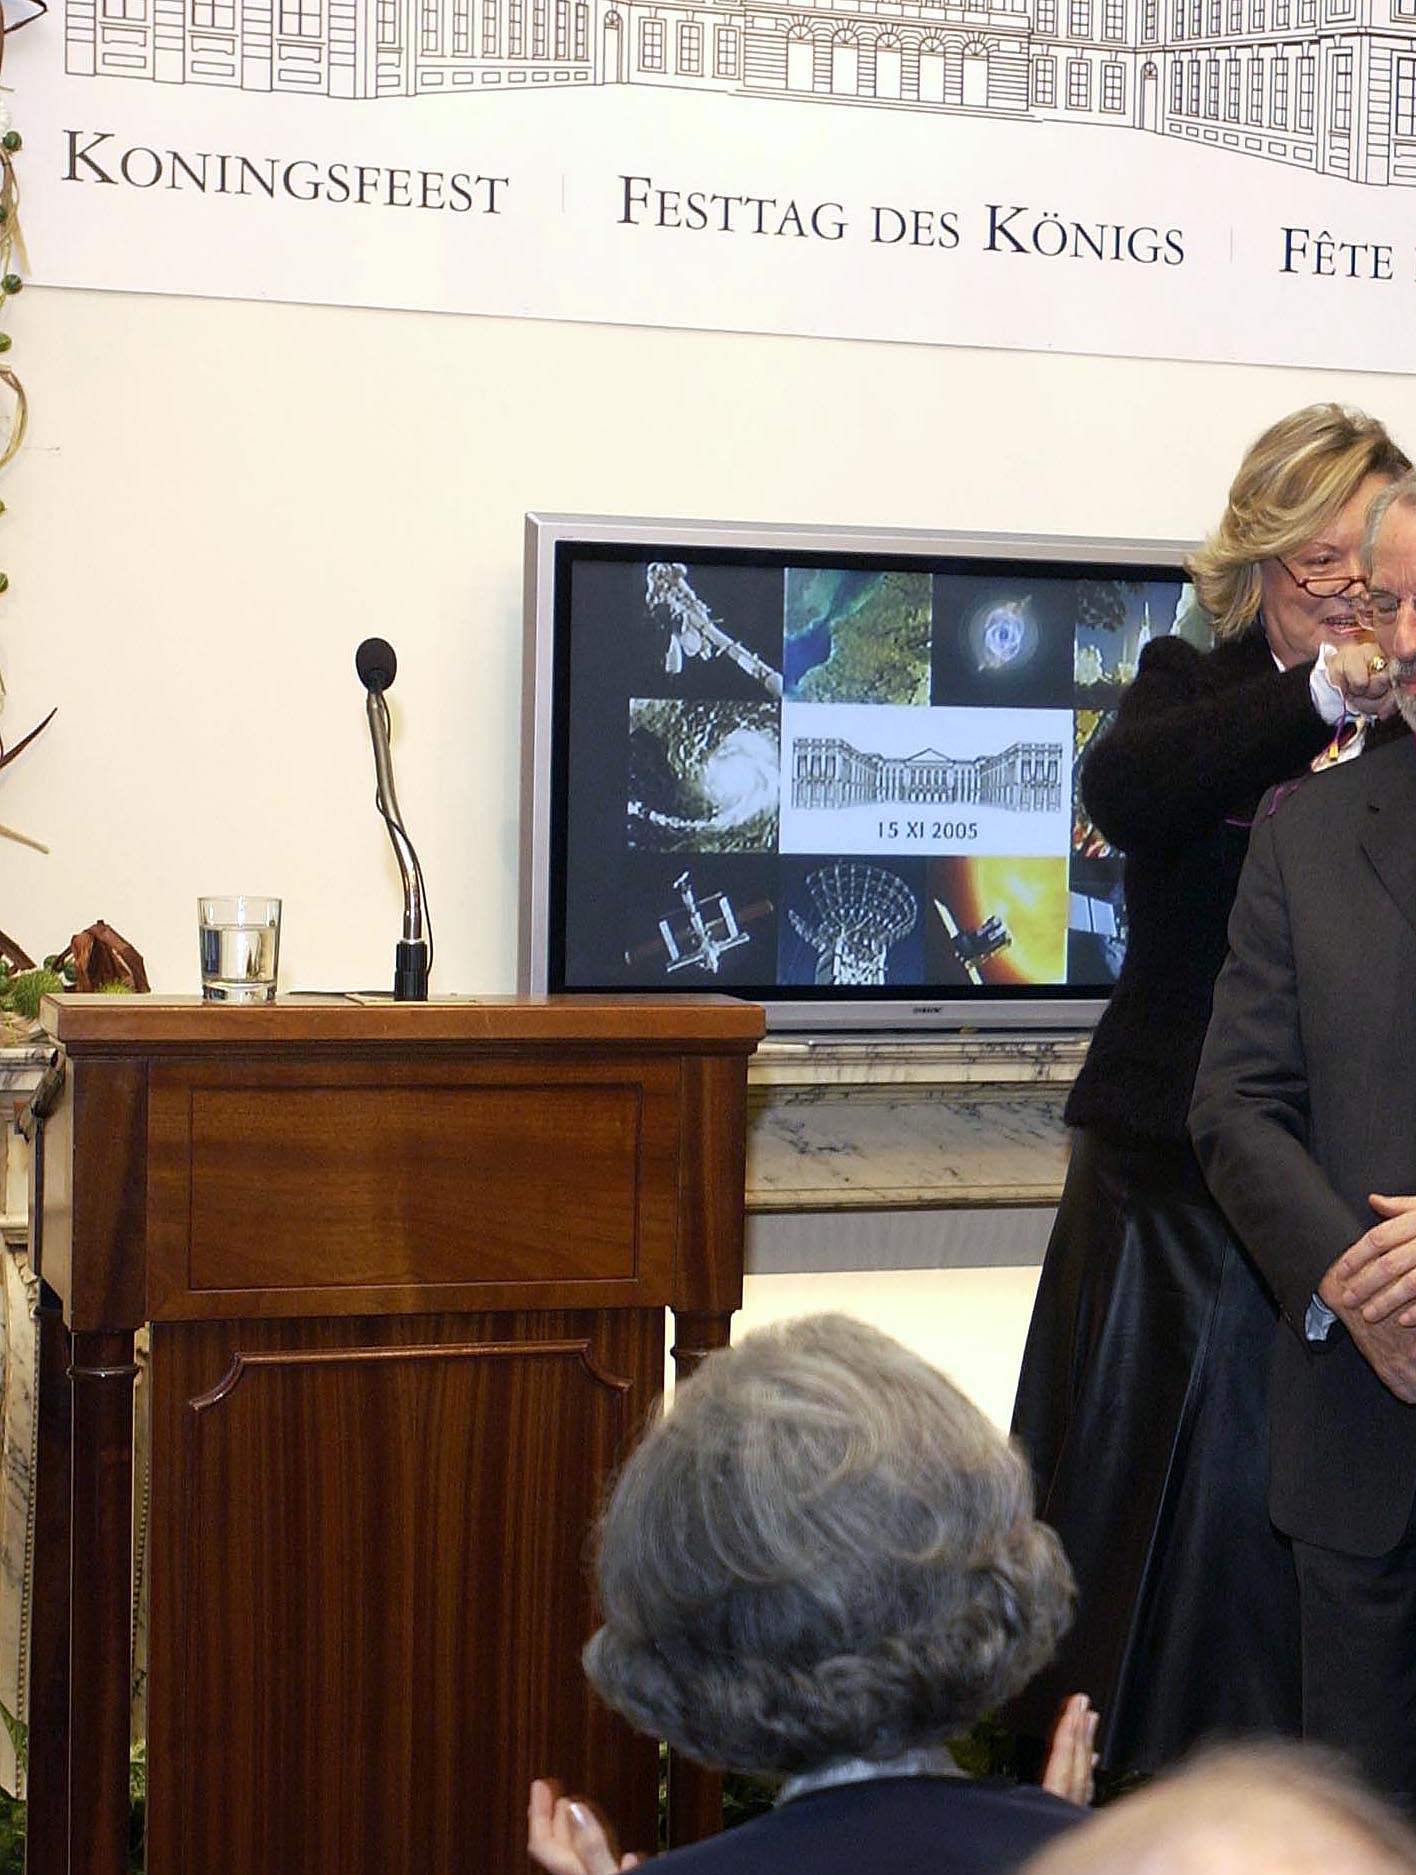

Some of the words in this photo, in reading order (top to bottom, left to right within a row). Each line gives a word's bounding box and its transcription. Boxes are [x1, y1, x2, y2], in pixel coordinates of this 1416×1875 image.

[61, 129, 509, 215] KONINGSFEEST
[617, 175, 847, 241] FESTTAG
[871, 207, 960, 249] DES
[983, 204, 1185, 266] KÖNIGS
[1279, 227, 1393, 280] FÊTE
[879, 821, 899, 839] 15
[906, 821, 925, 839] XI
[932, 821, 978, 840] 2005
